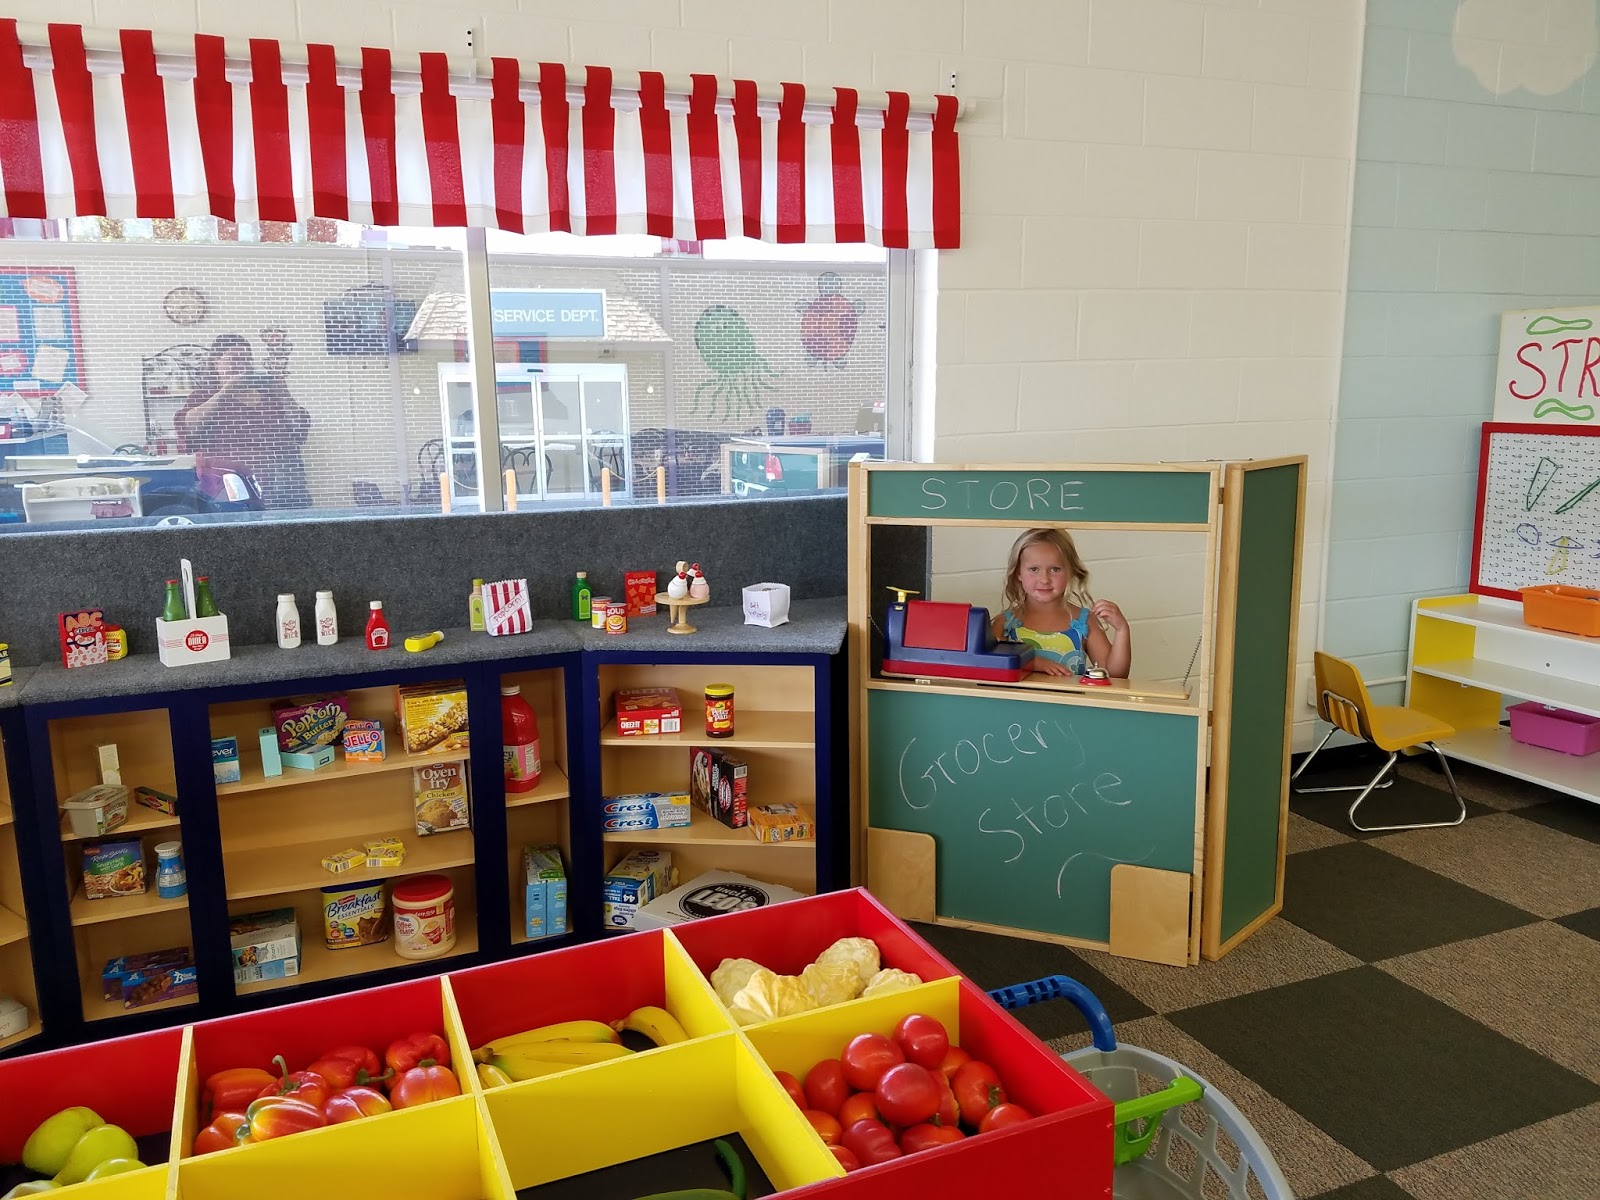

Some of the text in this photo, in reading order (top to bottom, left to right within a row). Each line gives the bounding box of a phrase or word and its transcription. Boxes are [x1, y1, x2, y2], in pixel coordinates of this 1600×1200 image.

[494, 309, 599, 322] SERVICE DEPT.
[921, 477, 1084, 510] STORE
[607, 607, 625, 616] SOUP
[66, 611, 103, 632] ABC
[281, 702, 341, 738] Popcorn
[302, 719, 334, 740] Butter
[212, 748, 234, 756] ever
[899, 720, 1085, 810] Grocery
[421, 768, 457, 780] Oven
[430, 777, 451, 790] fry
[604, 802, 653, 814] Crest
[604, 817, 653, 829] Crest
[978, 772, 1132, 863] Store
[715, 886, 749, 899] UNCLE
[324, 890, 382, 918] Breakfast
[338, 904, 374, 920] ESSENTIALS
